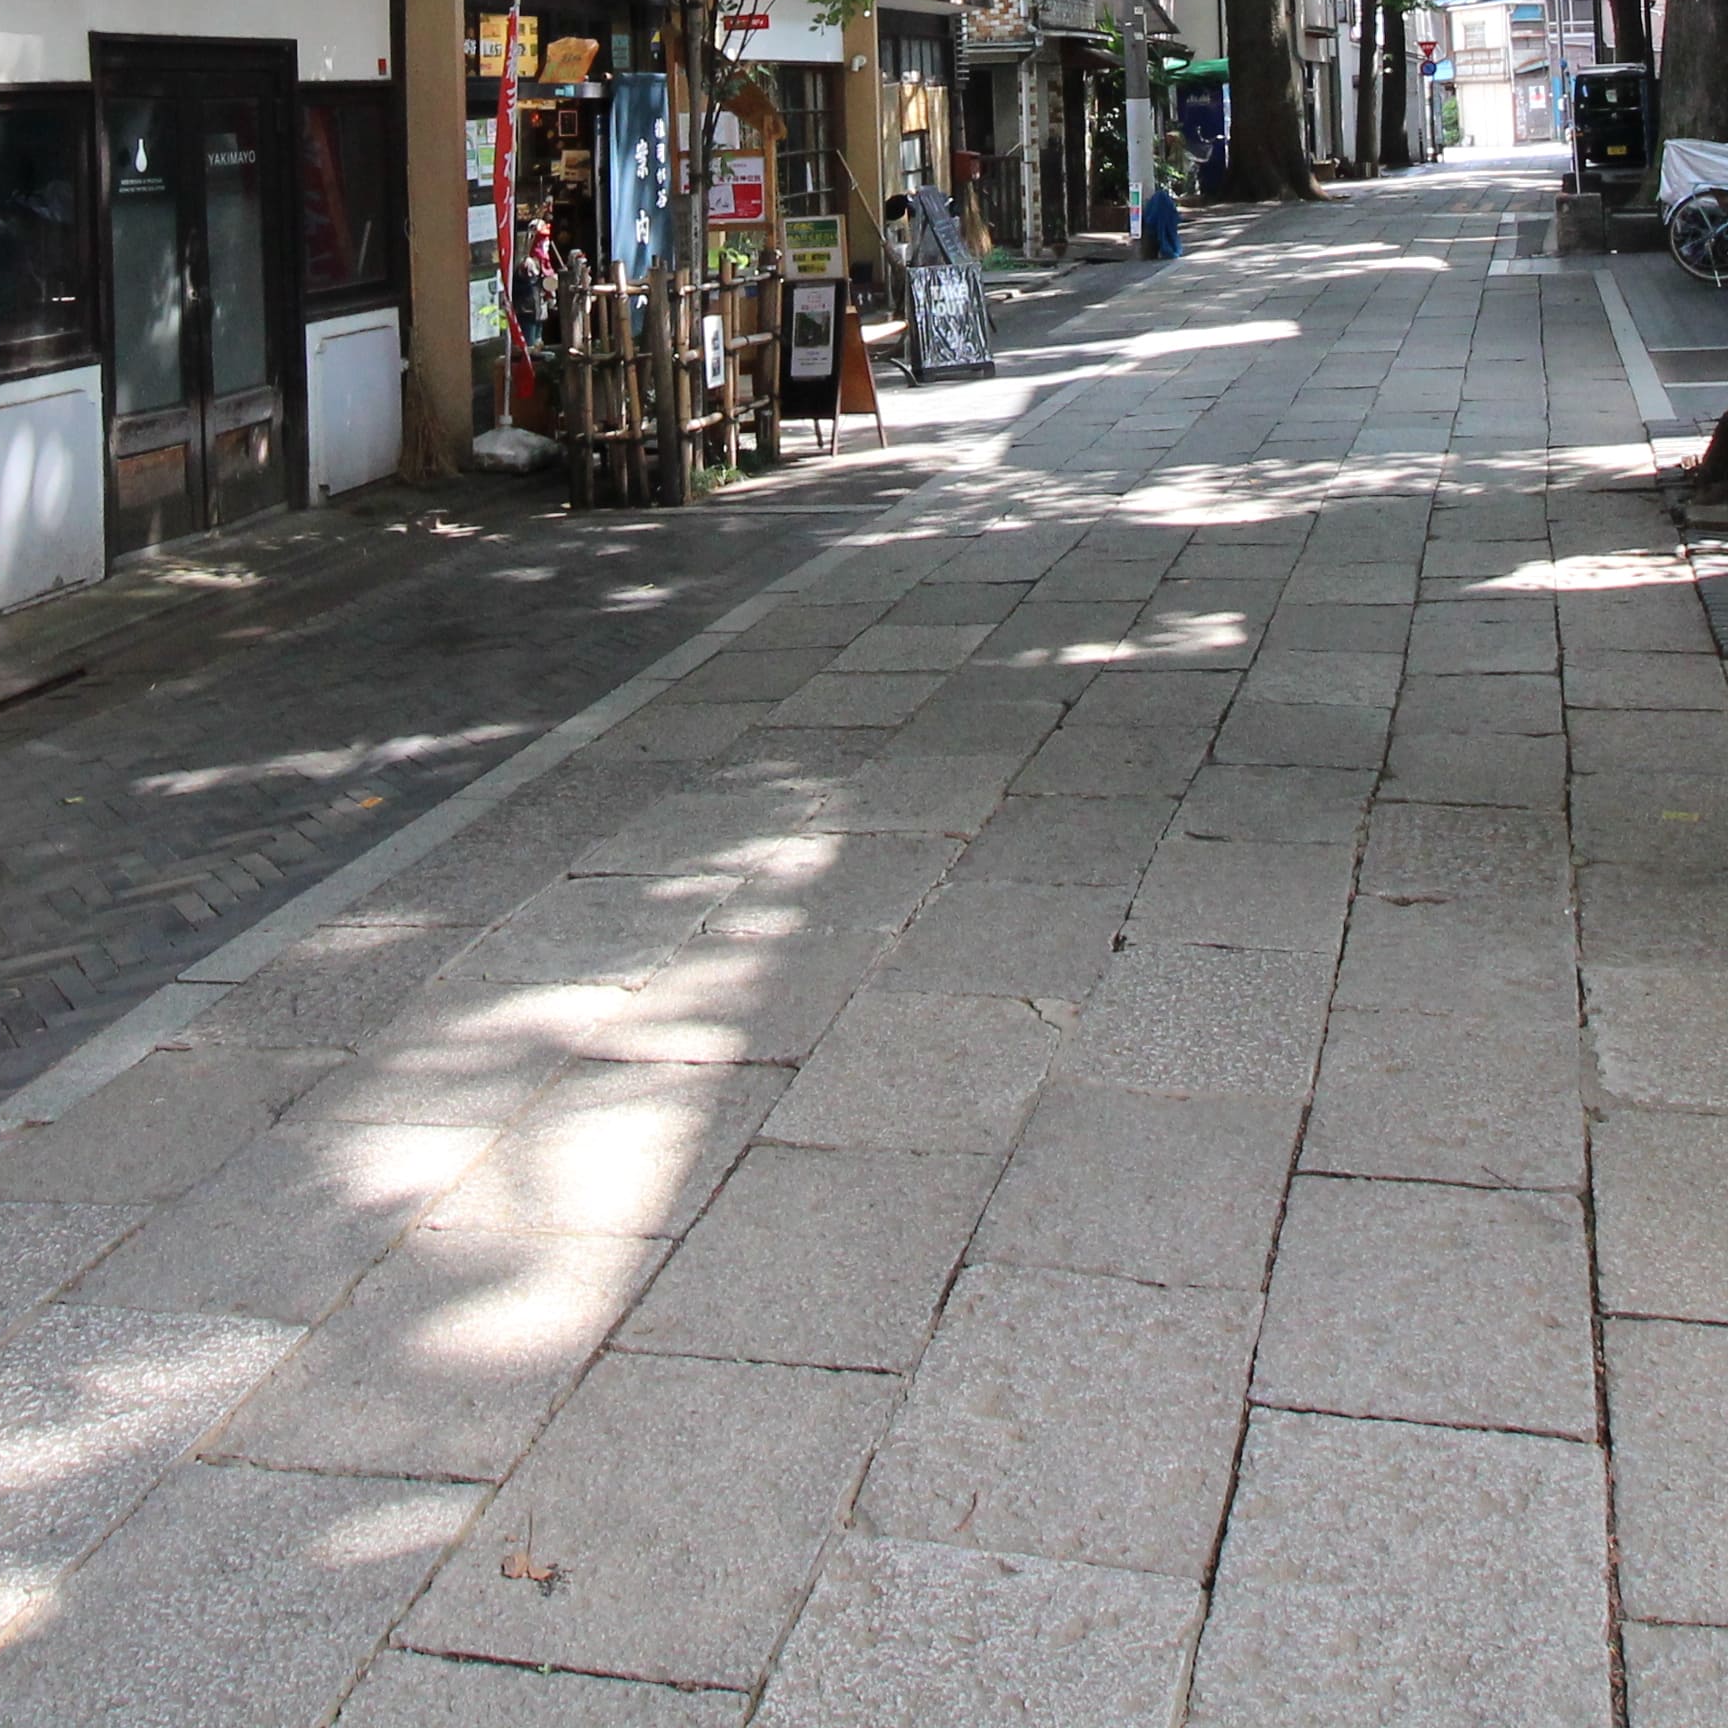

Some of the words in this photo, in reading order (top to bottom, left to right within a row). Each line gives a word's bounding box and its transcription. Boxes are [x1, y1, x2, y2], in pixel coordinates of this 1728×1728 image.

[207, 149, 256, 166] YAKIMAYO
[930, 283, 969, 301] TAKE
[936, 302, 964, 316] OUT
